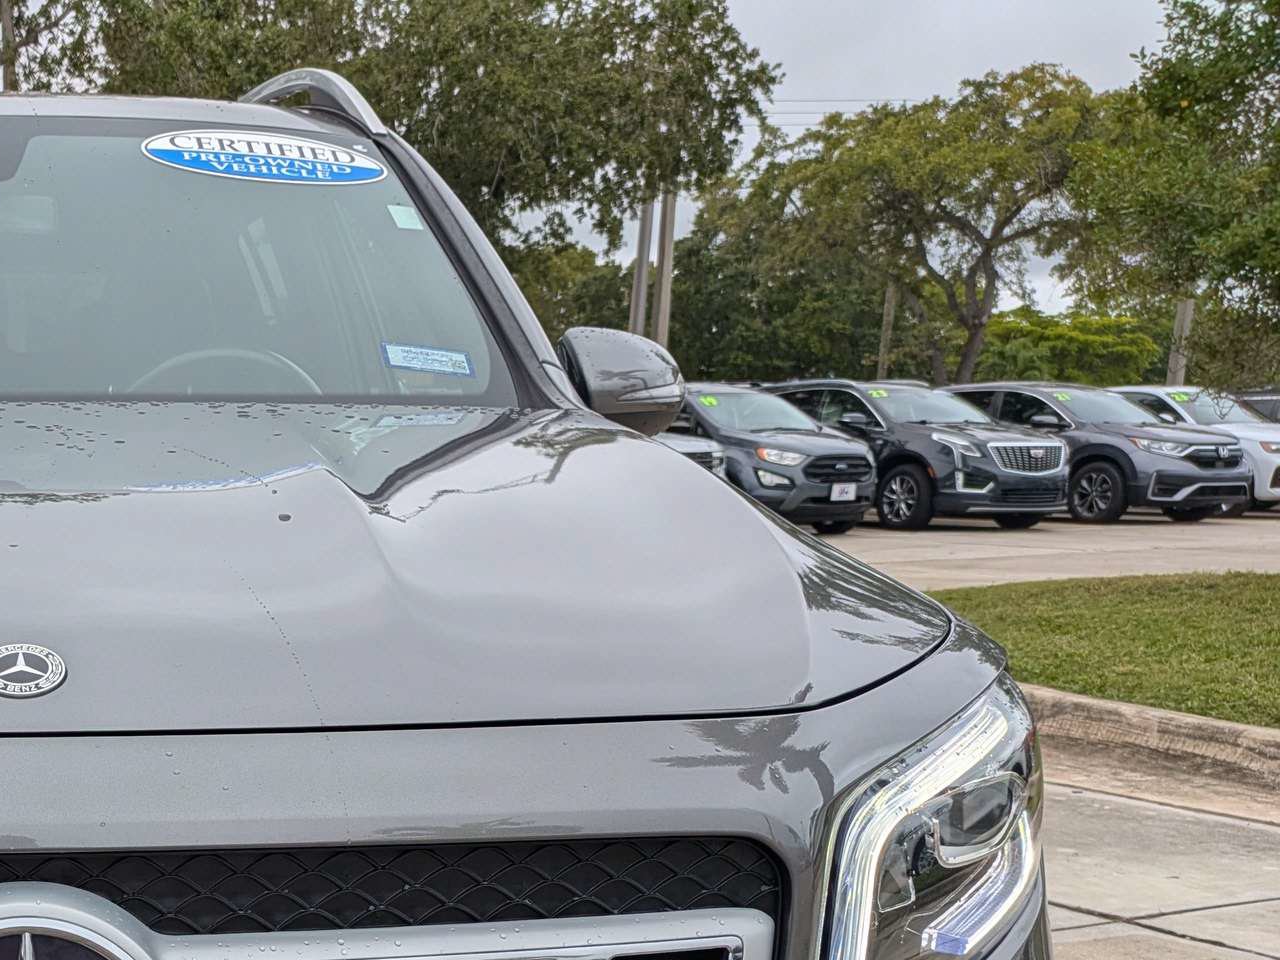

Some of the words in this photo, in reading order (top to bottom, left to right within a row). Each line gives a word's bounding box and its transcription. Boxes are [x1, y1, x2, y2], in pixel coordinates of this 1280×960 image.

[169, 134, 356, 165] CERTIFIED
[182, 151, 352, 174] PRE-OWNED
[210, 161, 333, 180] VEHICLE
[6, 684, 38, 692] BENZ
